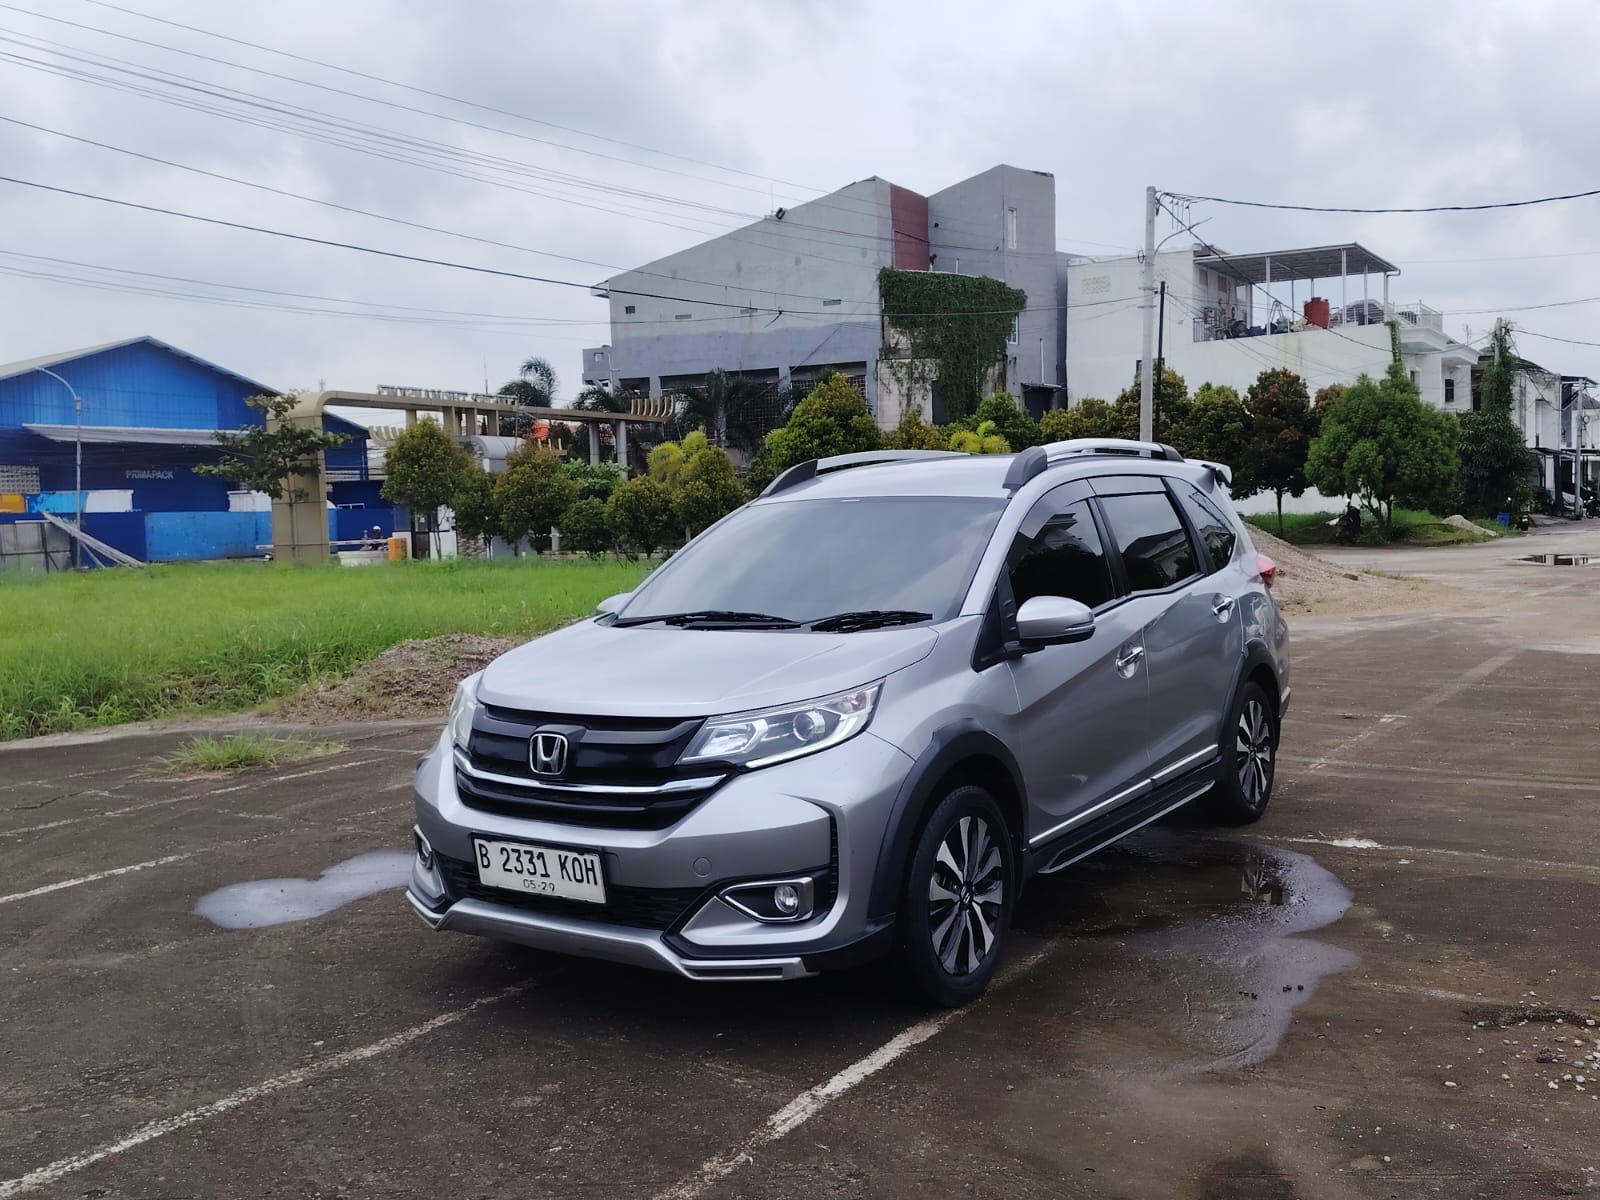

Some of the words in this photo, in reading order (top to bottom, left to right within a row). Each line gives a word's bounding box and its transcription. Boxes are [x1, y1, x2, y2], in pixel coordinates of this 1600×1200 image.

[478, 843, 490, 869] B
[500, 847, 550, 878] 2331
[558, 854, 598, 886] KOH
